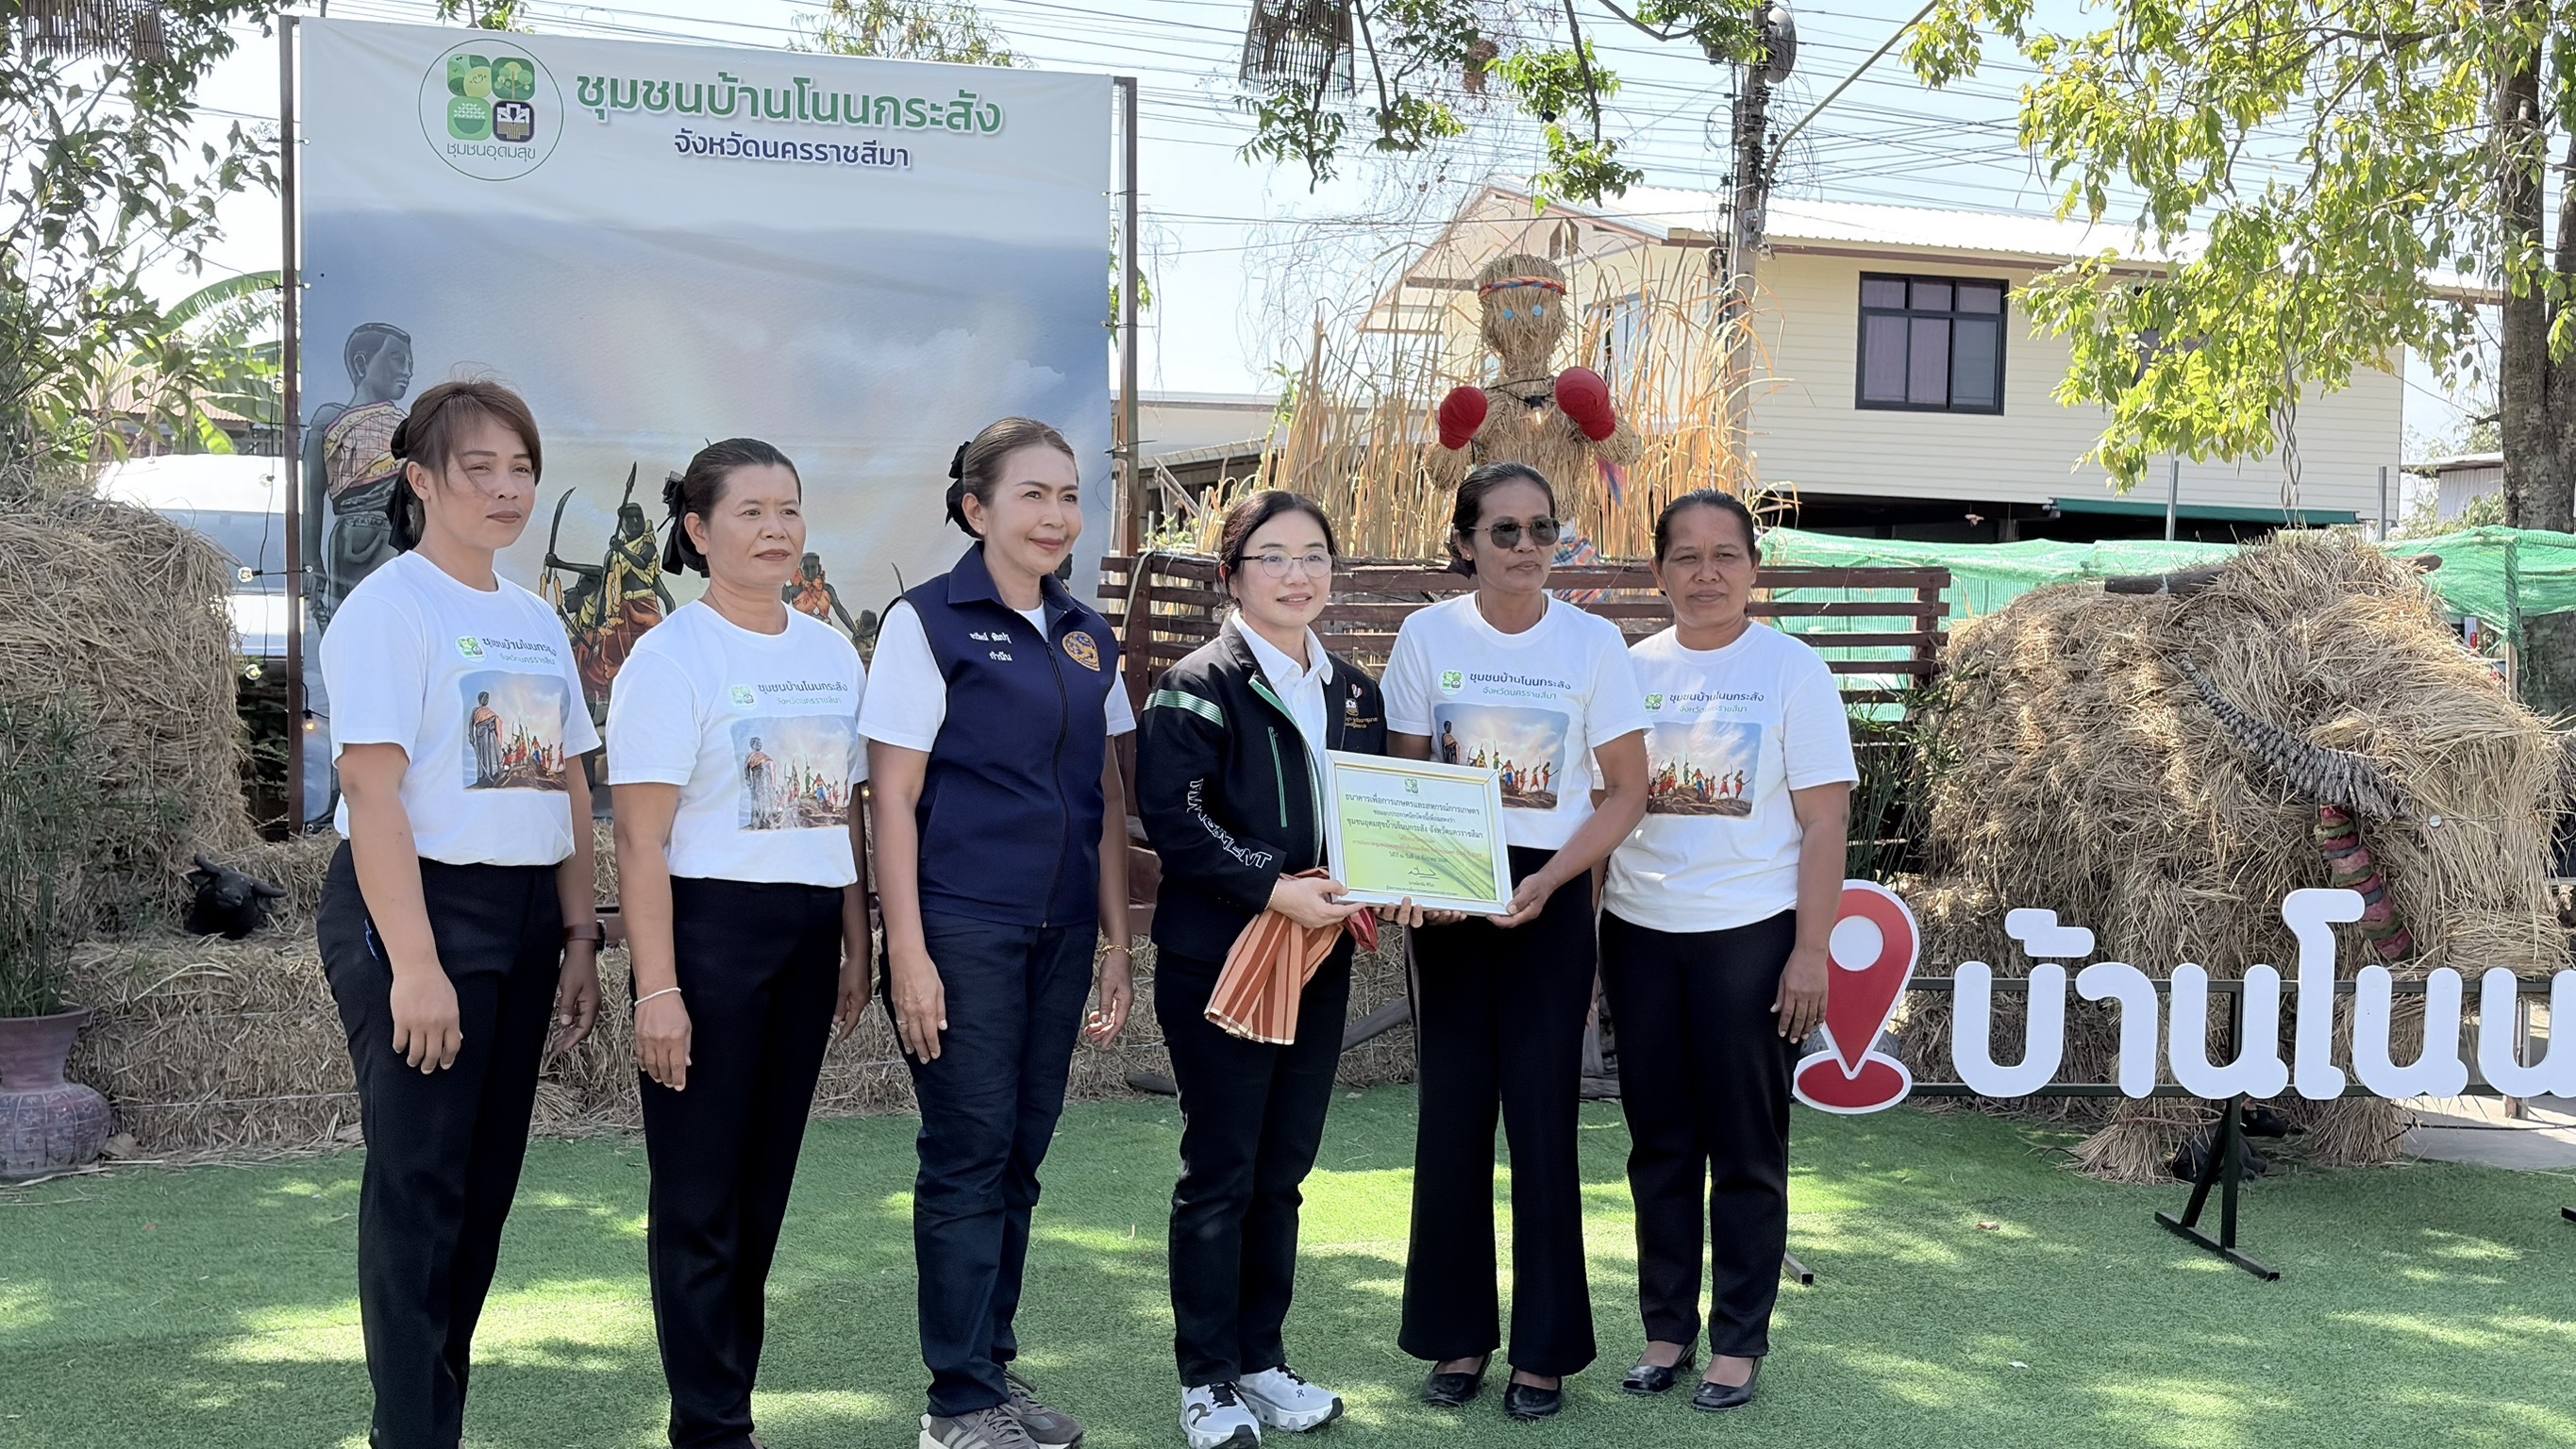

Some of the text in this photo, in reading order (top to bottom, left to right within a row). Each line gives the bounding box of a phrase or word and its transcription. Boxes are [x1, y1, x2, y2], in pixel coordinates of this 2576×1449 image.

[577, 71, 1002, 133] ชุมชนบ้านโนนกระสัง
[446, 142, 536, 162] ชุมชนอุดมสุข
[674, 128, 911, 167] จังหวัดนครราชสีมา
[758, 680, 848, 695] ชุมชนบ้านโนนกระสัง
[1469, 672, 1571, 690] ชุมชนบ้านโนนกระสัง
[1482, 686, 1557, 700] จังหวัดนครราชสีมา
[1669, 691, 1765, 704] ชุมชนบ้านโนนกระสัง
